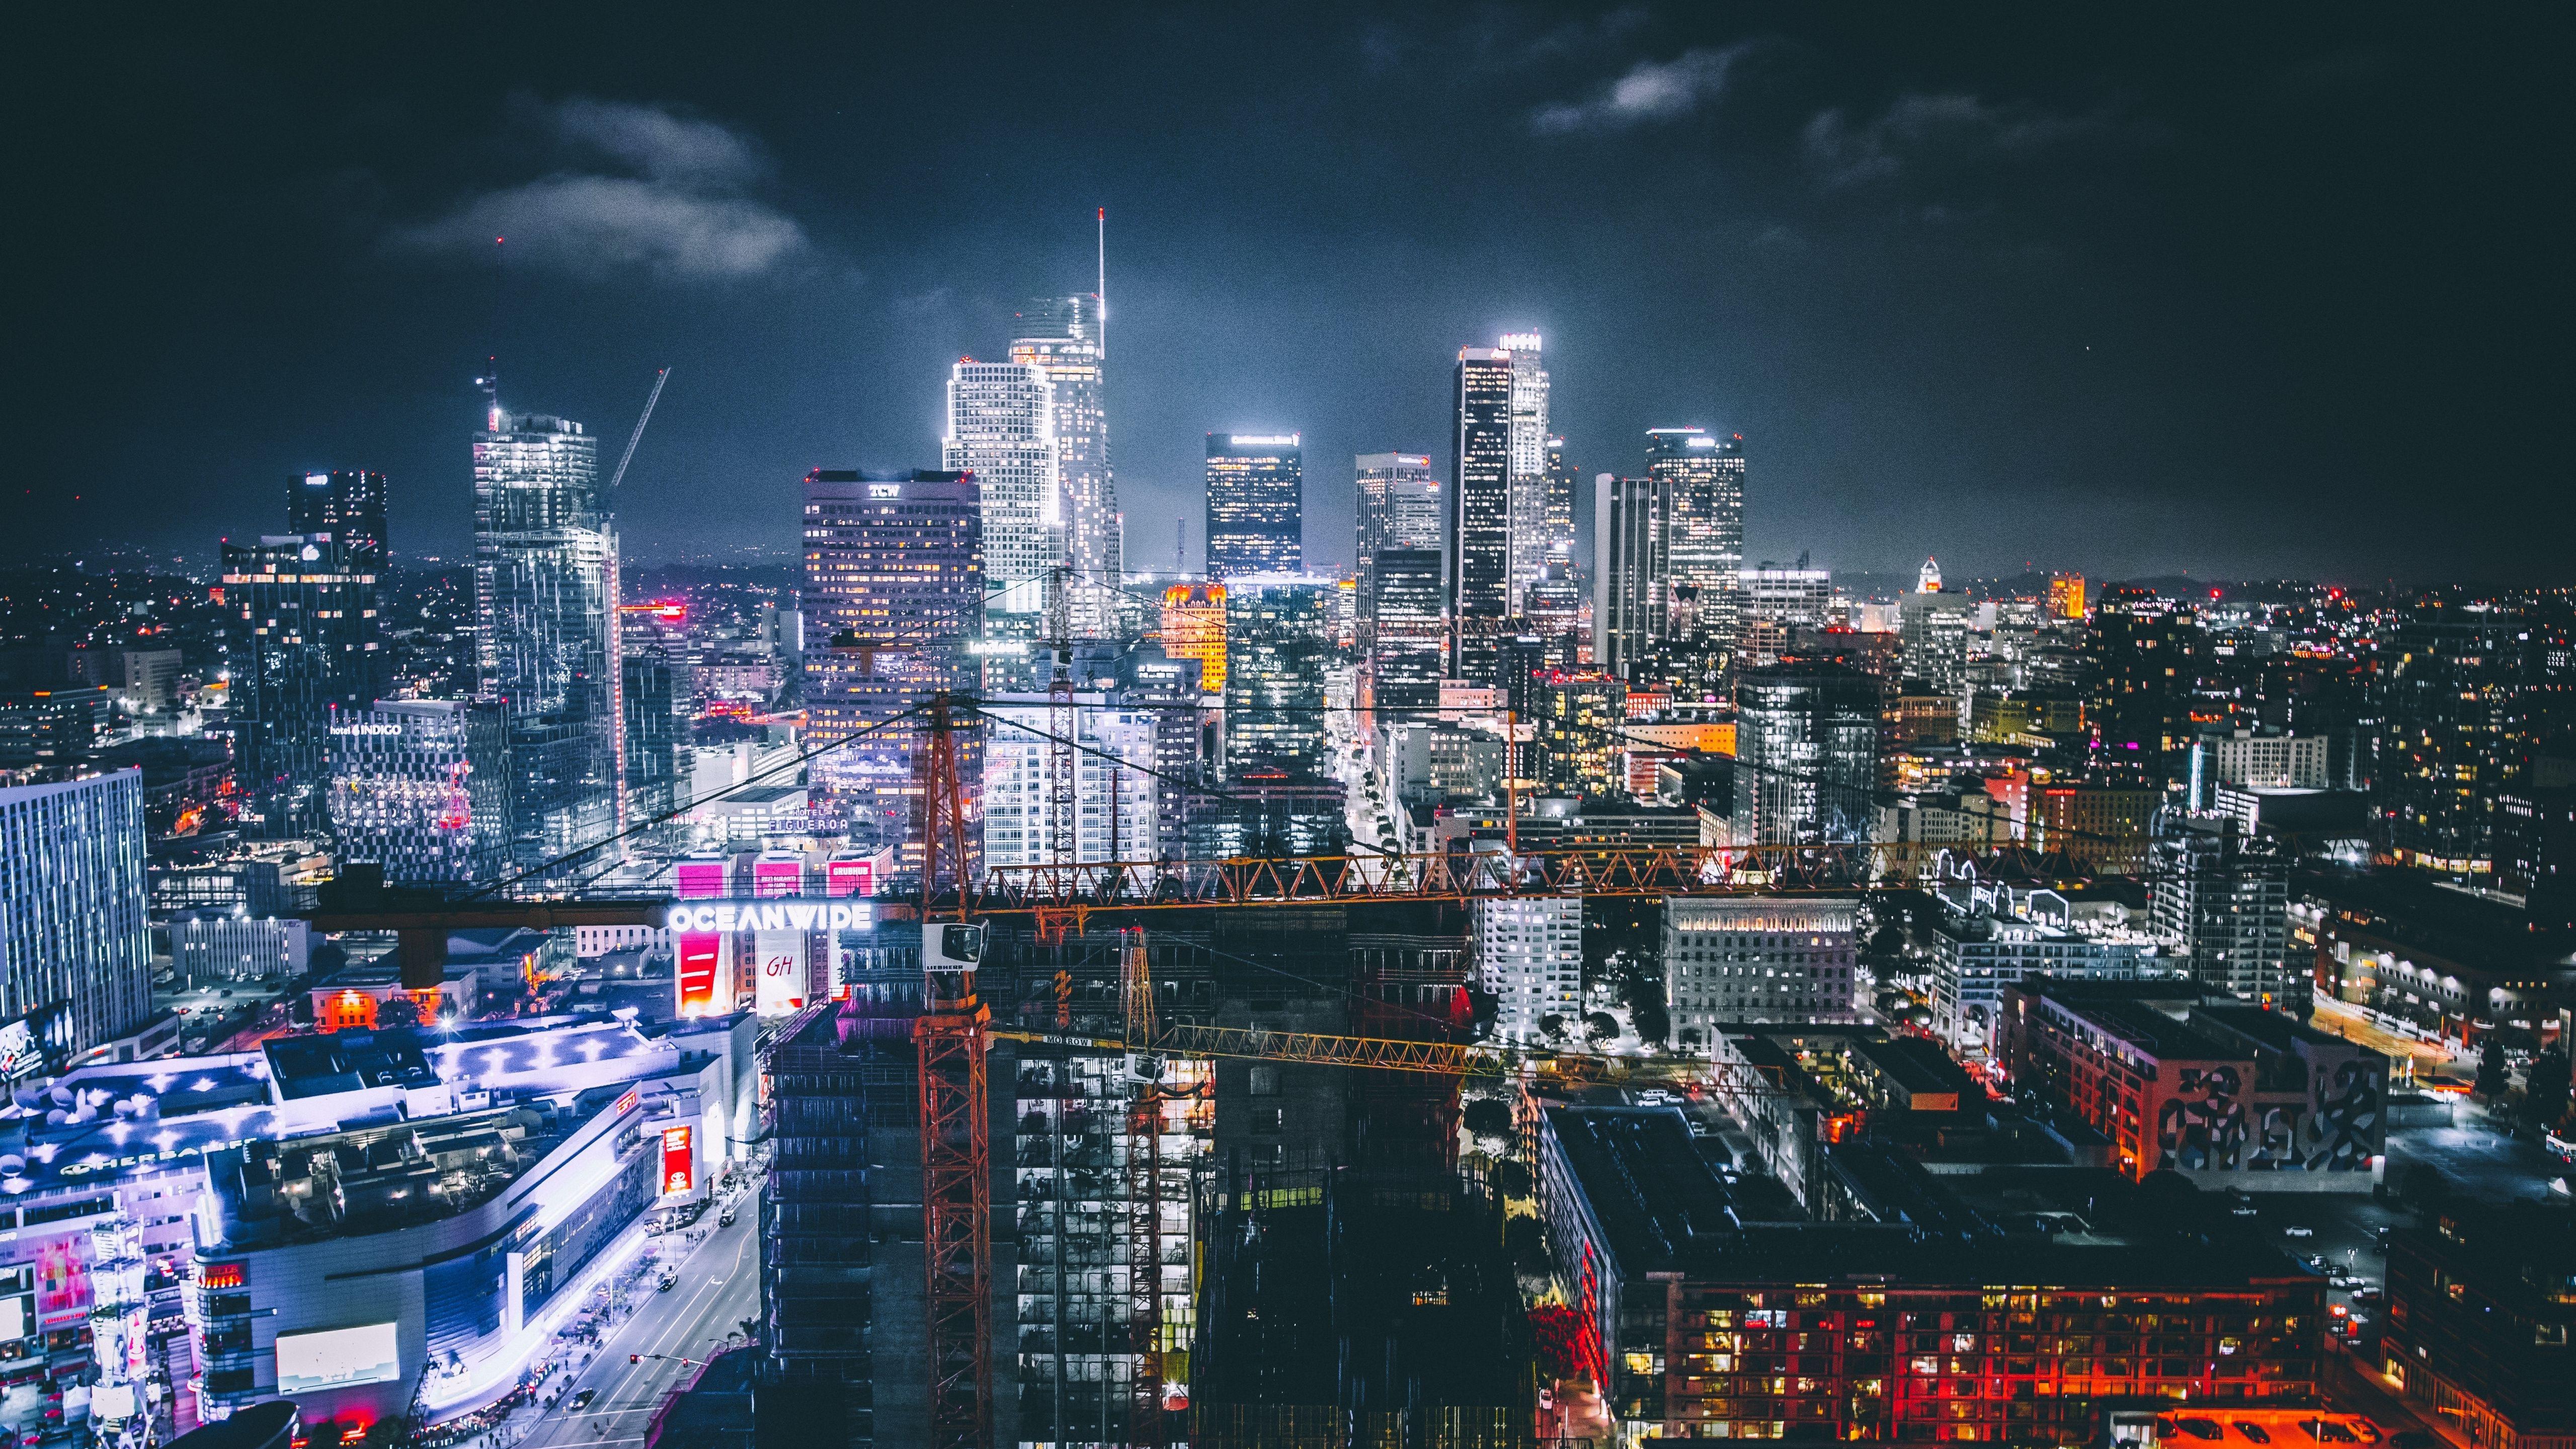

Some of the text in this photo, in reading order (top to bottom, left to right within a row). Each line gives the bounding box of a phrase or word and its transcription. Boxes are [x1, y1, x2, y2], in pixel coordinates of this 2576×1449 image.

[868, 484, 900, 497] TCW
[330, 725, 402, 736] hotel INDIGO
[768, 819, 848, 831] FIGUEROA
[833, 866, 869, 875] GRUBHUB
[668, 905, 872, 932] OCEANWIDE
[766, 956, 793, 977] GH
